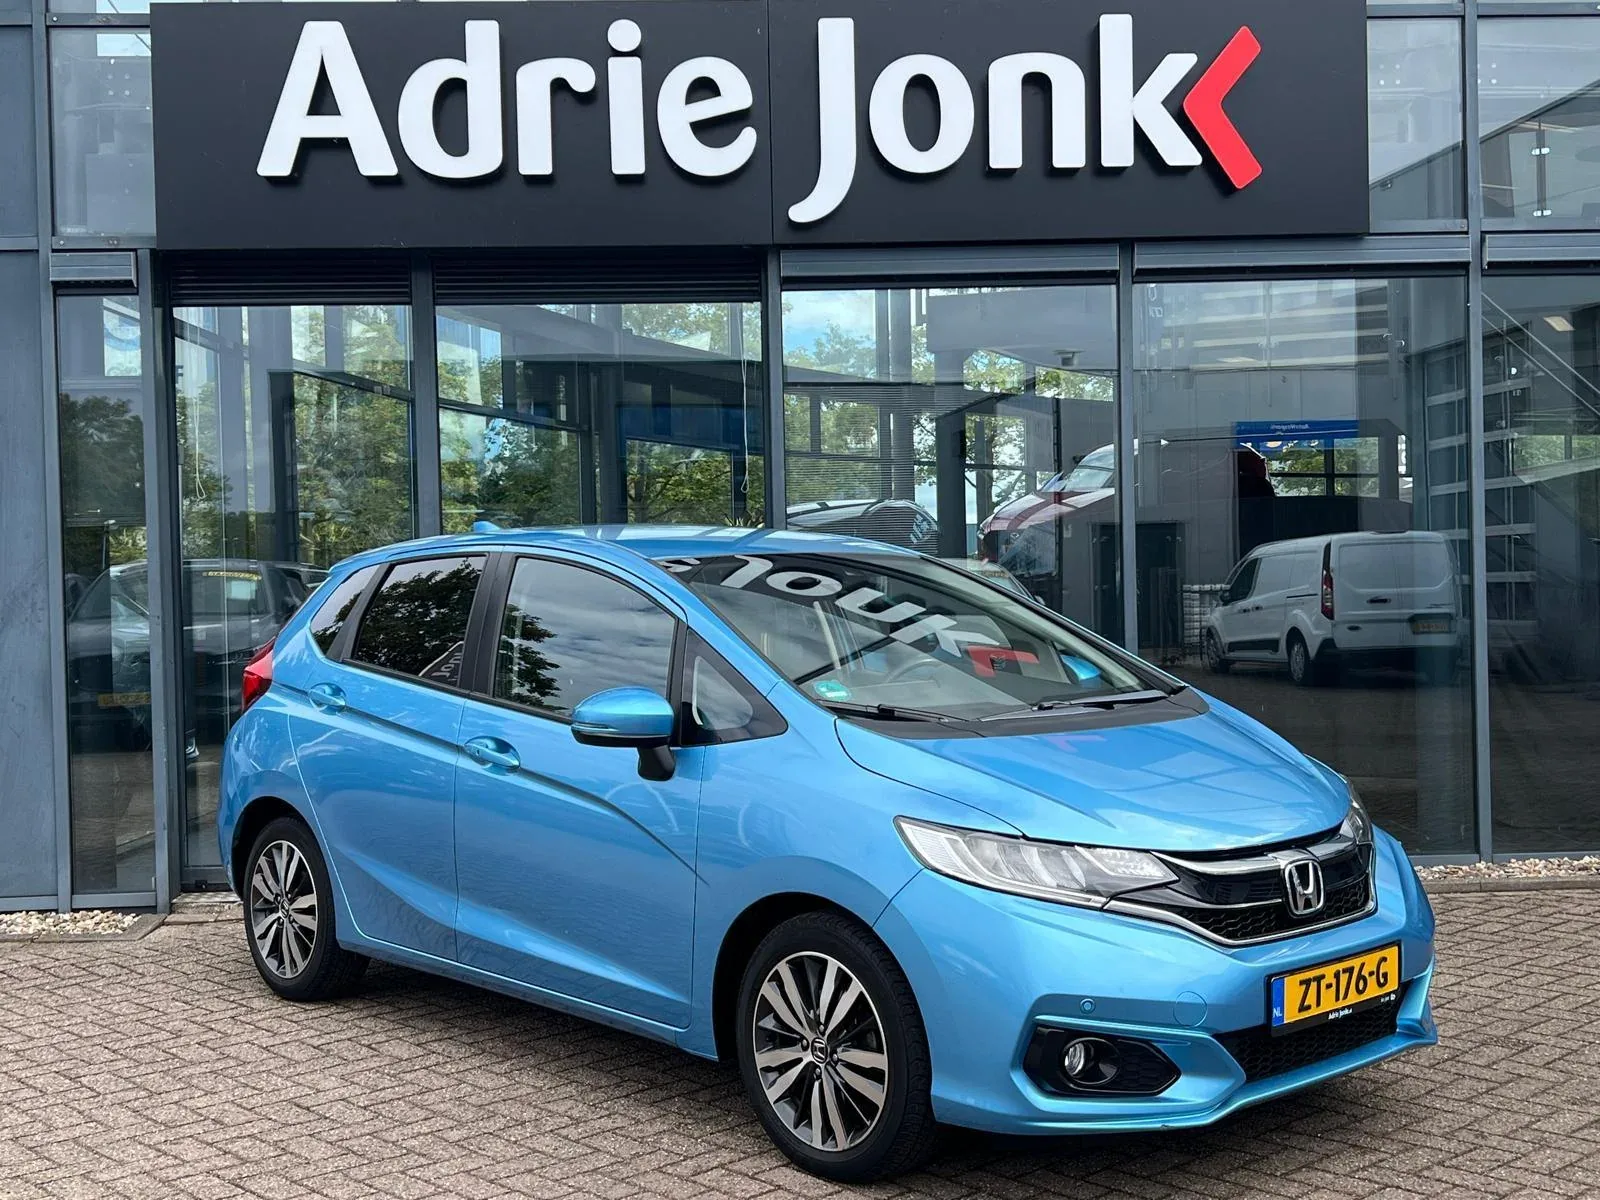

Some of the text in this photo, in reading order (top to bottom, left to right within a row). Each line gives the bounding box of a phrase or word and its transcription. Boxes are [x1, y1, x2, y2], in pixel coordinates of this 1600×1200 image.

[256, 13, 1203, 224] Adrie Jonk
[1272, 956, 1389, 1019] NL ZT-176-G
